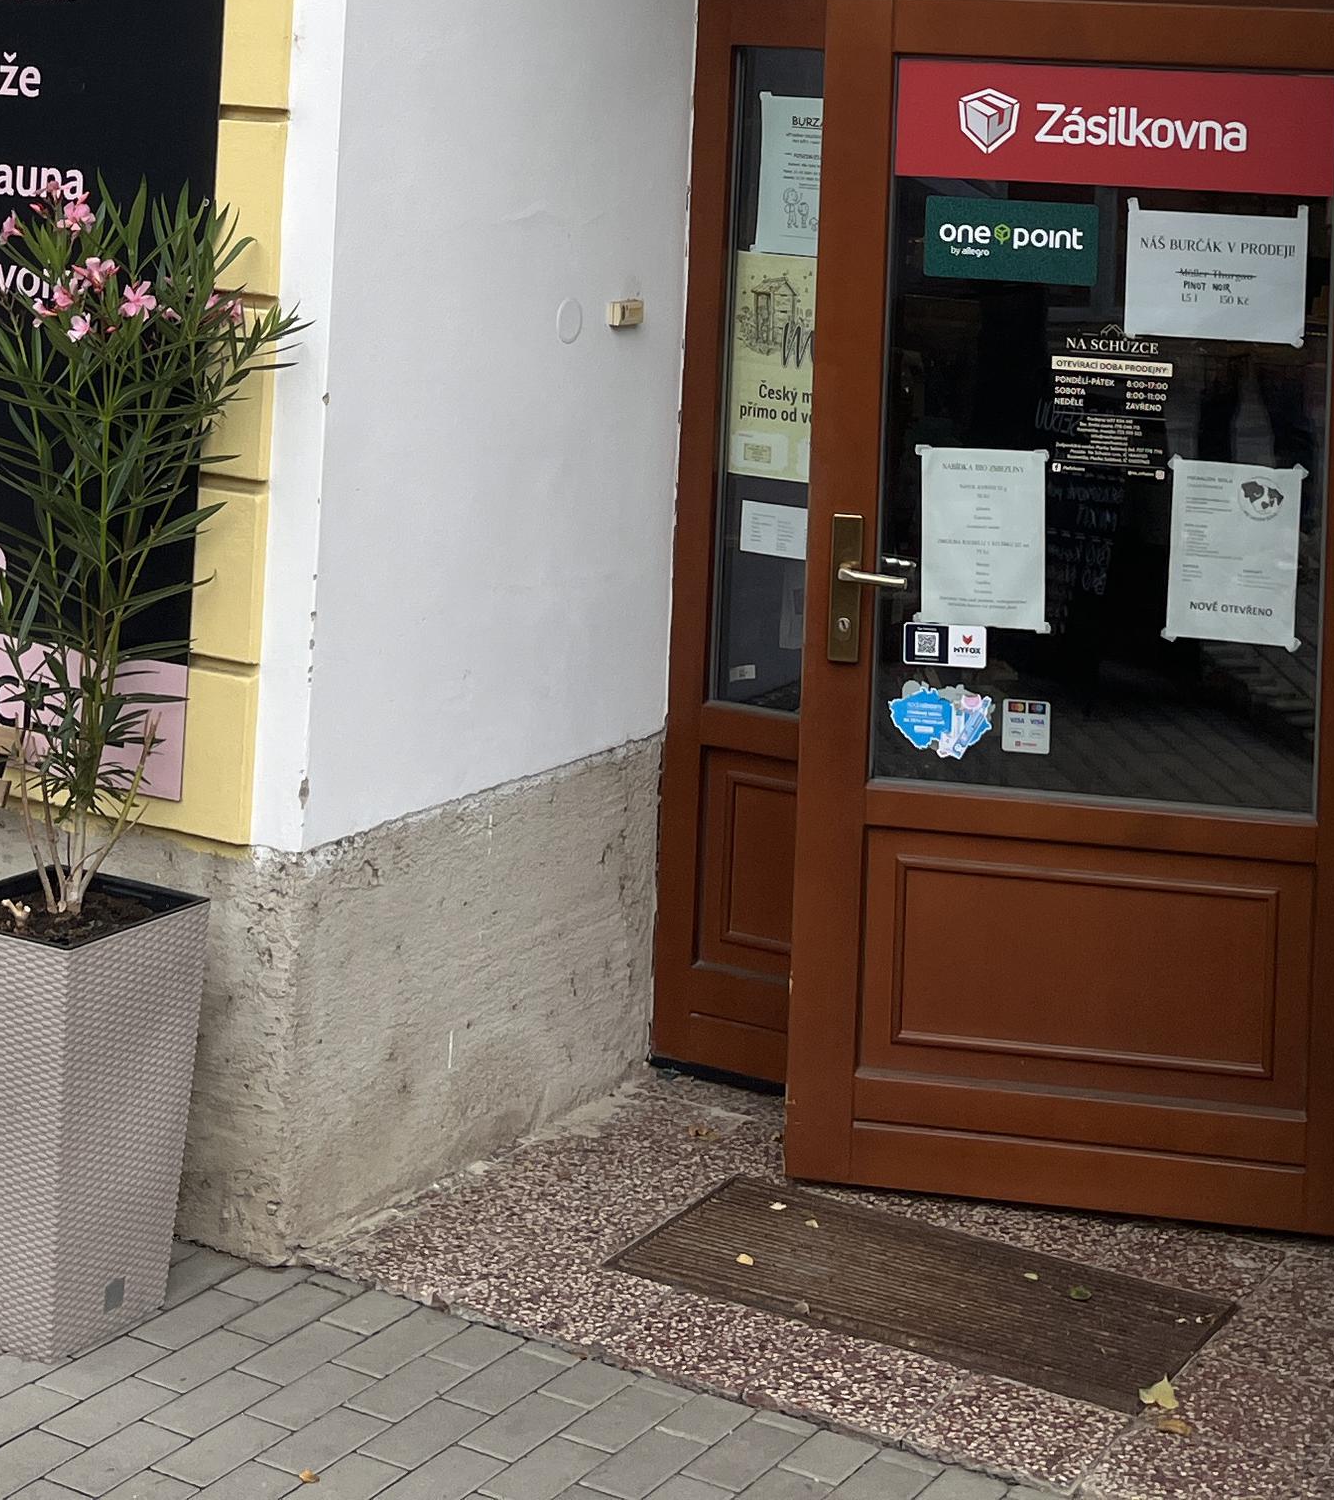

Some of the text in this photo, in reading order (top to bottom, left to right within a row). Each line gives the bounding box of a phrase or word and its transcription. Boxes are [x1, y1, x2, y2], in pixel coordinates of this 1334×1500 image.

[792, 115, 824, 128] BURZ
[1035, 103, 1247, 152] Zásilkovna
[939, 223, 1084, 250] one point
[950, 245, 990, 258] by allegro
[1140, 235, 1296, 259] NÁŠ BURČÁK V PRODEJI!
[1183, 280, 1232, 294] PINOT NOIR
[1066, 337, 1159, 355] NA SCHŮZCE
[1056, 360, 1098, 370] OTEVÍRACÍ
[1100, 362, 1123, 371] DOBA
[758, 380, 798, 406] Český
[1054, 386, 1086, 396] SOBOTA
[1054, 397, 1162, 412] NEDĚLE ZAVŘENO
[739, 401, 777, 420] přímo
[781, 407, 797, 423] od
[1220, 604, 1273, 617] OTEVŘENO
[1030, 718, 1045, 726] VISA
